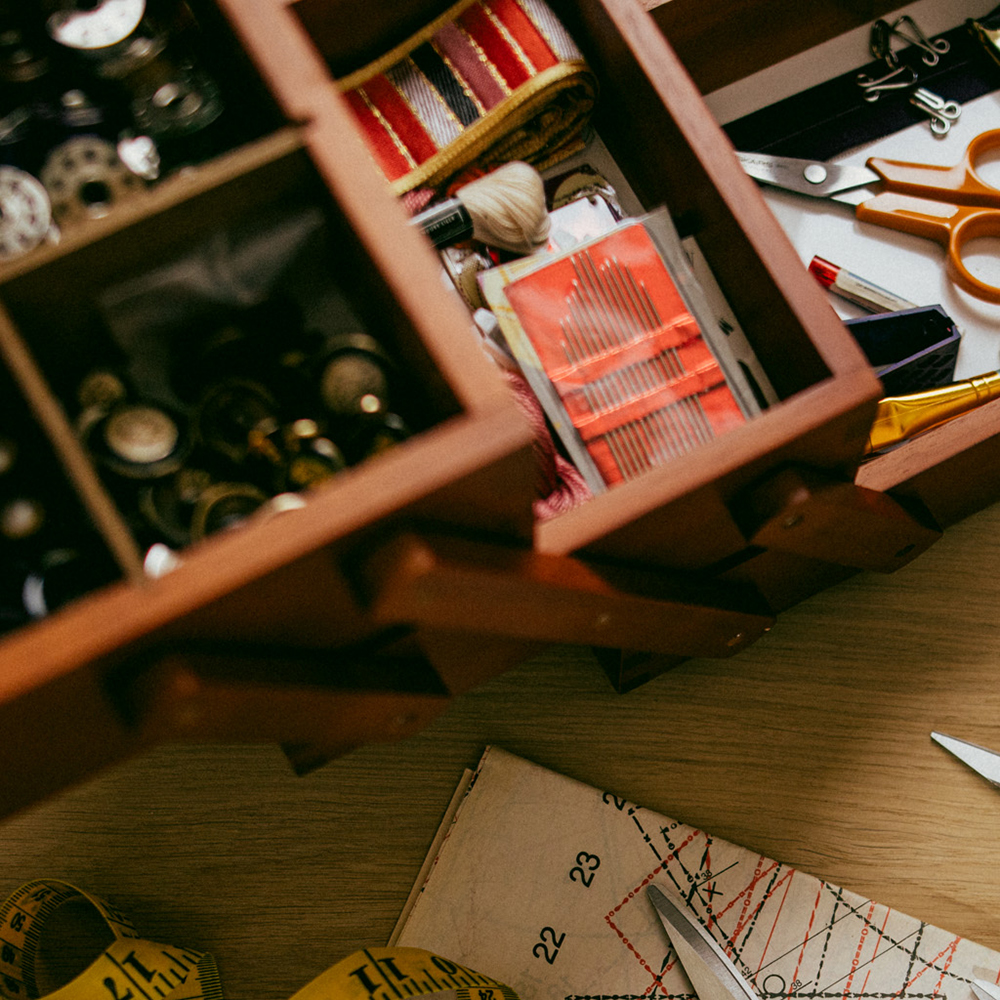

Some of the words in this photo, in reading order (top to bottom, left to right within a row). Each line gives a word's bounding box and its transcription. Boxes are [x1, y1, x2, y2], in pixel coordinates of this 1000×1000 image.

[569, 851, 601, 888] 23
[700, 869, 713, 881] 38
[532, 926, 566, 965] 22
[349, 957, 409, 995] 11
[740, 966, 753, 977] 42
[790, 979, 803, 990] 38
